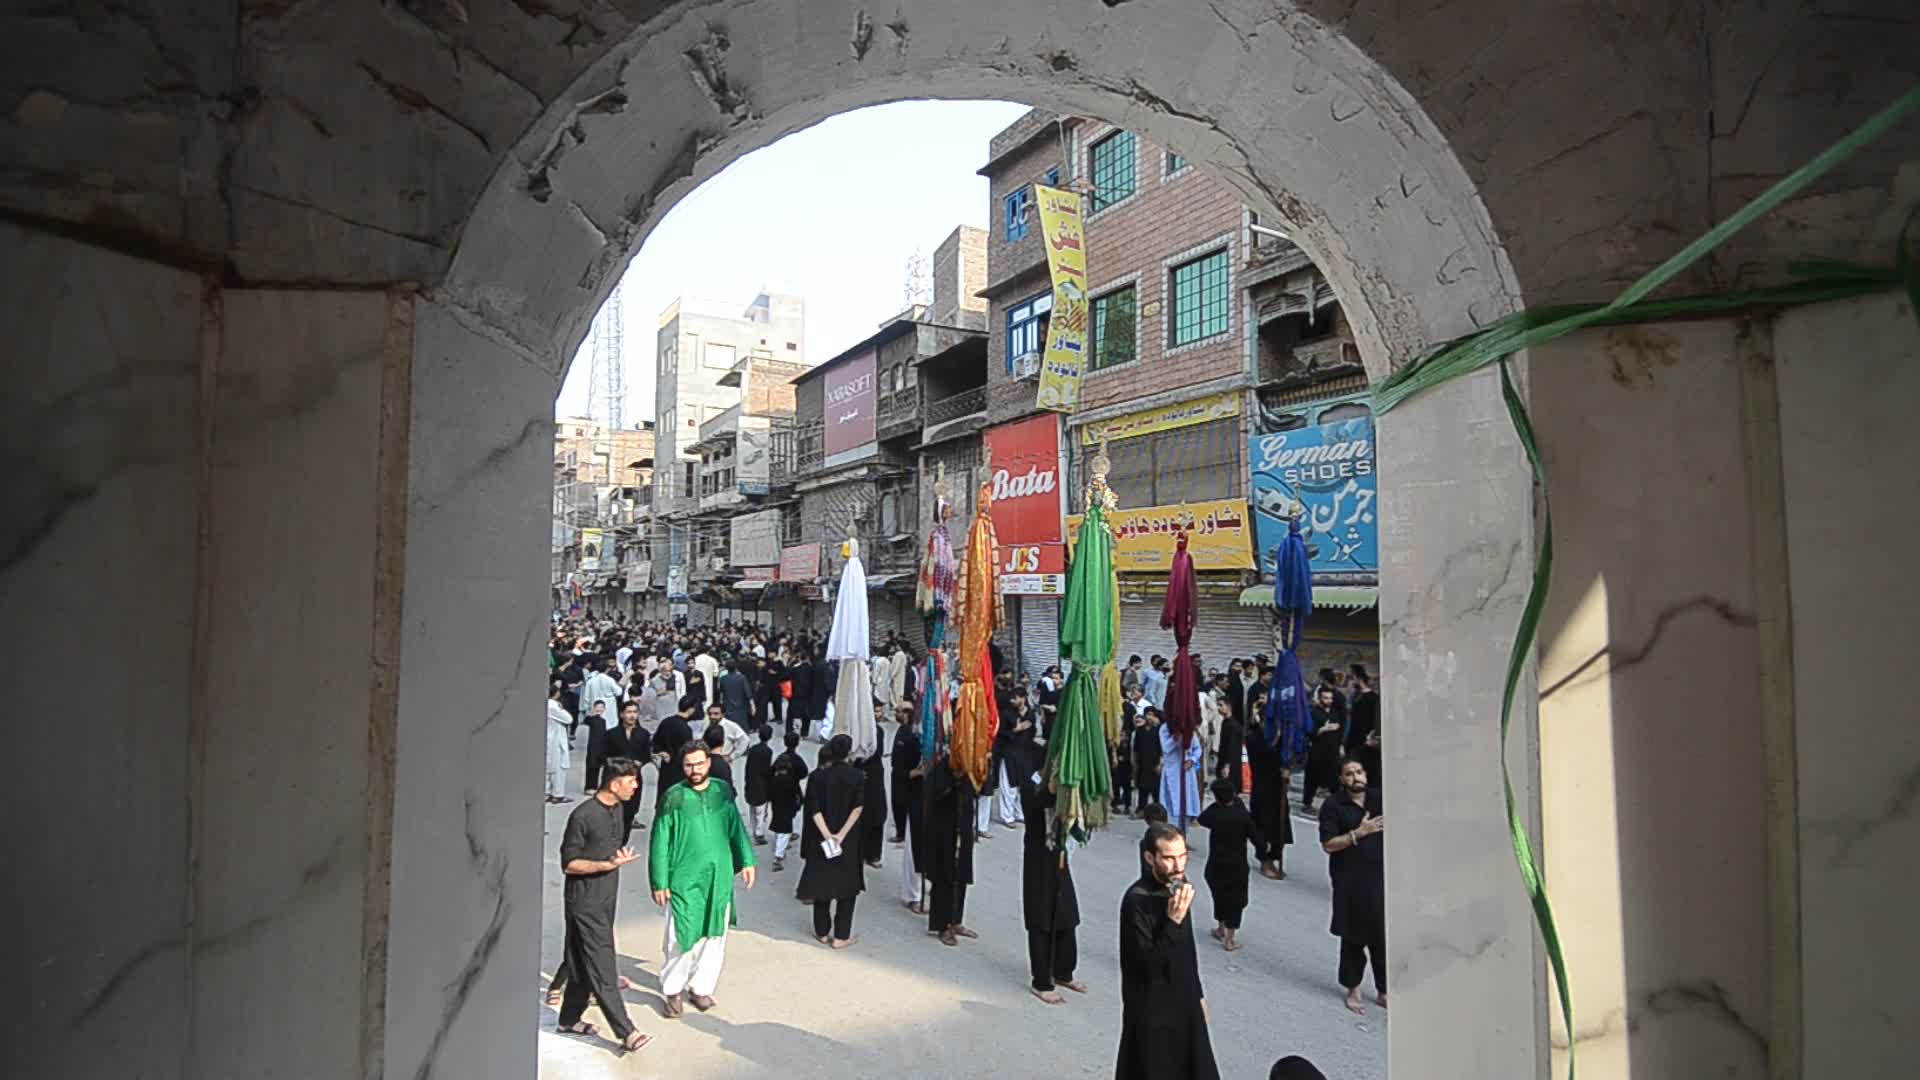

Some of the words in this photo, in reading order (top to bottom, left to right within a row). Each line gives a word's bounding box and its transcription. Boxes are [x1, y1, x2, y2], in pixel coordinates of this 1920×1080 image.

[1052, 333, 1082, 355] پشاور
[1258, 435, 1370, 471] German
[991, 464, 1056, 501] Bata
[1285, 460, 1372, 484] SHOES
[1312, 478, 1376, 532] جرمن
[1198, 506, 1242, 537] پشاور
[1005, 547, 1040, 573] JCS
[1329, 527, 1363, 561] شوز
